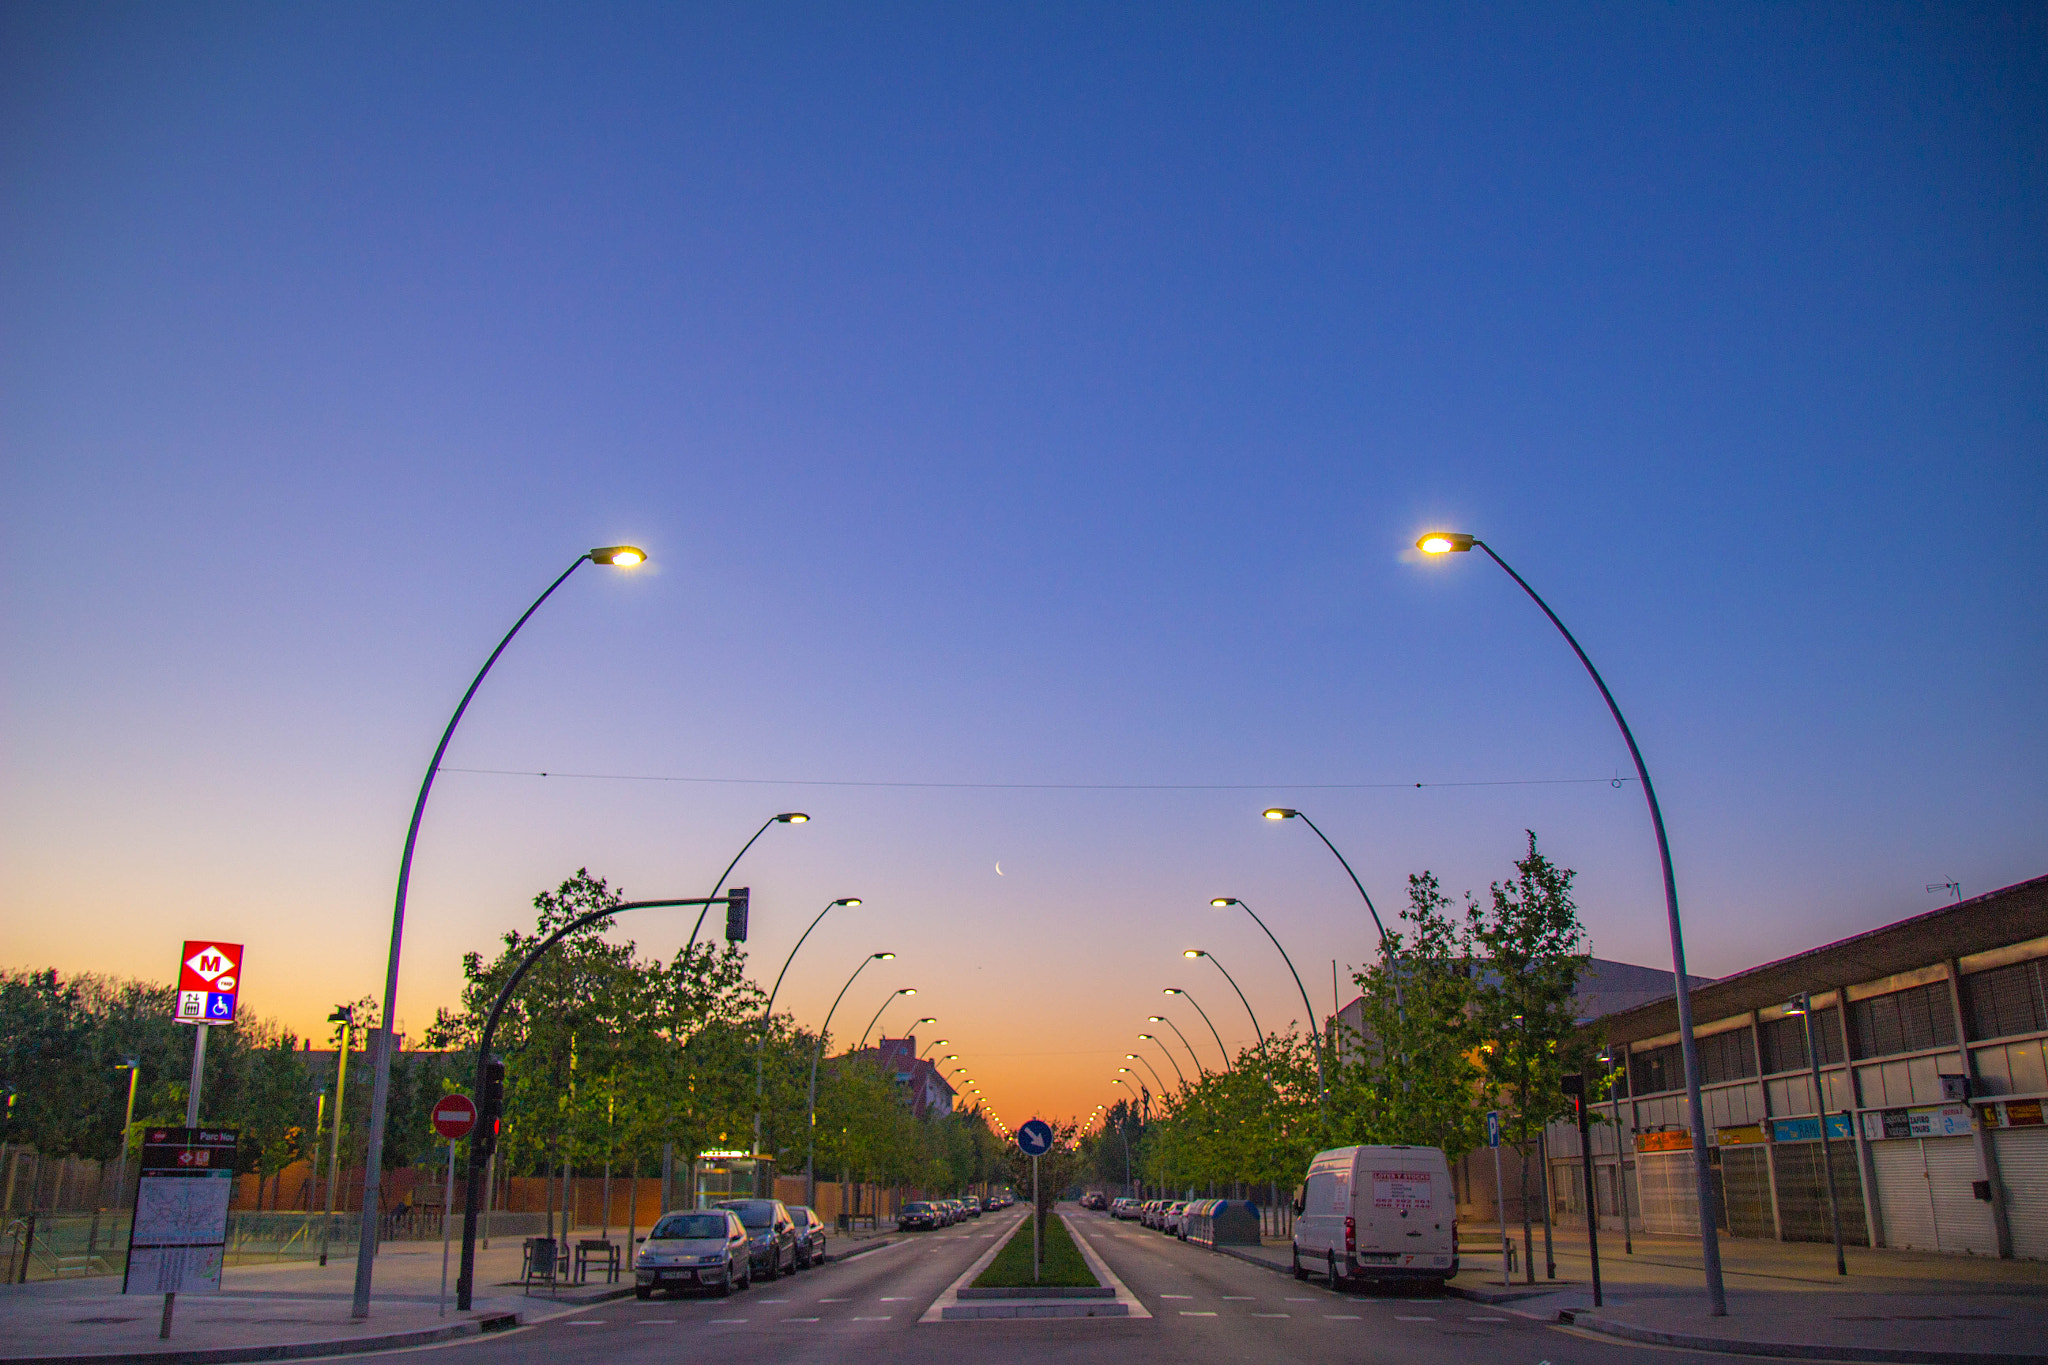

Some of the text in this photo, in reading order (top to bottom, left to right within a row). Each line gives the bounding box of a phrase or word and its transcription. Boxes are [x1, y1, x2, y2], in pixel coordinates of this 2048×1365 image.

[200, 955, 221, 972] M
[1909, 1116, 1929, 1124] ZAFIRO
[1490, 1117, 1496, 1144] P
[1912, 1125, 1930, 1133] TOURS
[200, 1132, 235, 1142] Parc Nou
